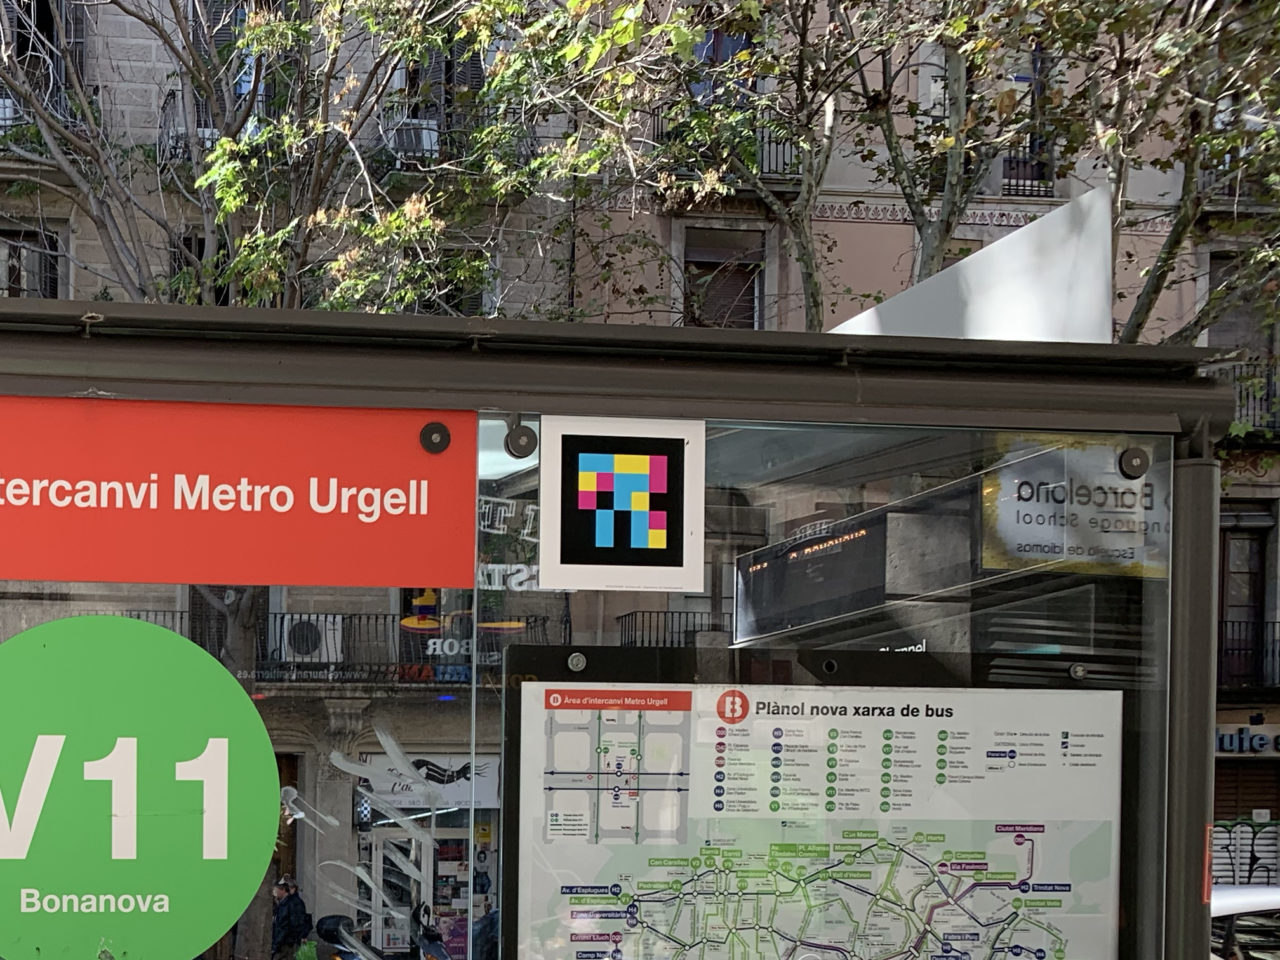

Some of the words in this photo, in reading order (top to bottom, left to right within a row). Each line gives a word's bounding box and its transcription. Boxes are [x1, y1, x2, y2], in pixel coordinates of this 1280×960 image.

[174, 474, 294, 513] Metro
[309, 477, 429, 523] Urgell
[564, 696, 581, 704] Àrea
[582, 697, 624, 705] d'intercanvi
[647, 699, 668, 707] Urgell
[755, 702, 805, 717] Plànol
[810, 706, 848, 717] nova
[853, 706, 896, 717] xarxa
[900, 704, 920, 717] de
[924, 704, 954, 718] bus
[573, 886, 609, 894] d'Esplugues
[20, 888, 170, 913] Bonanova
